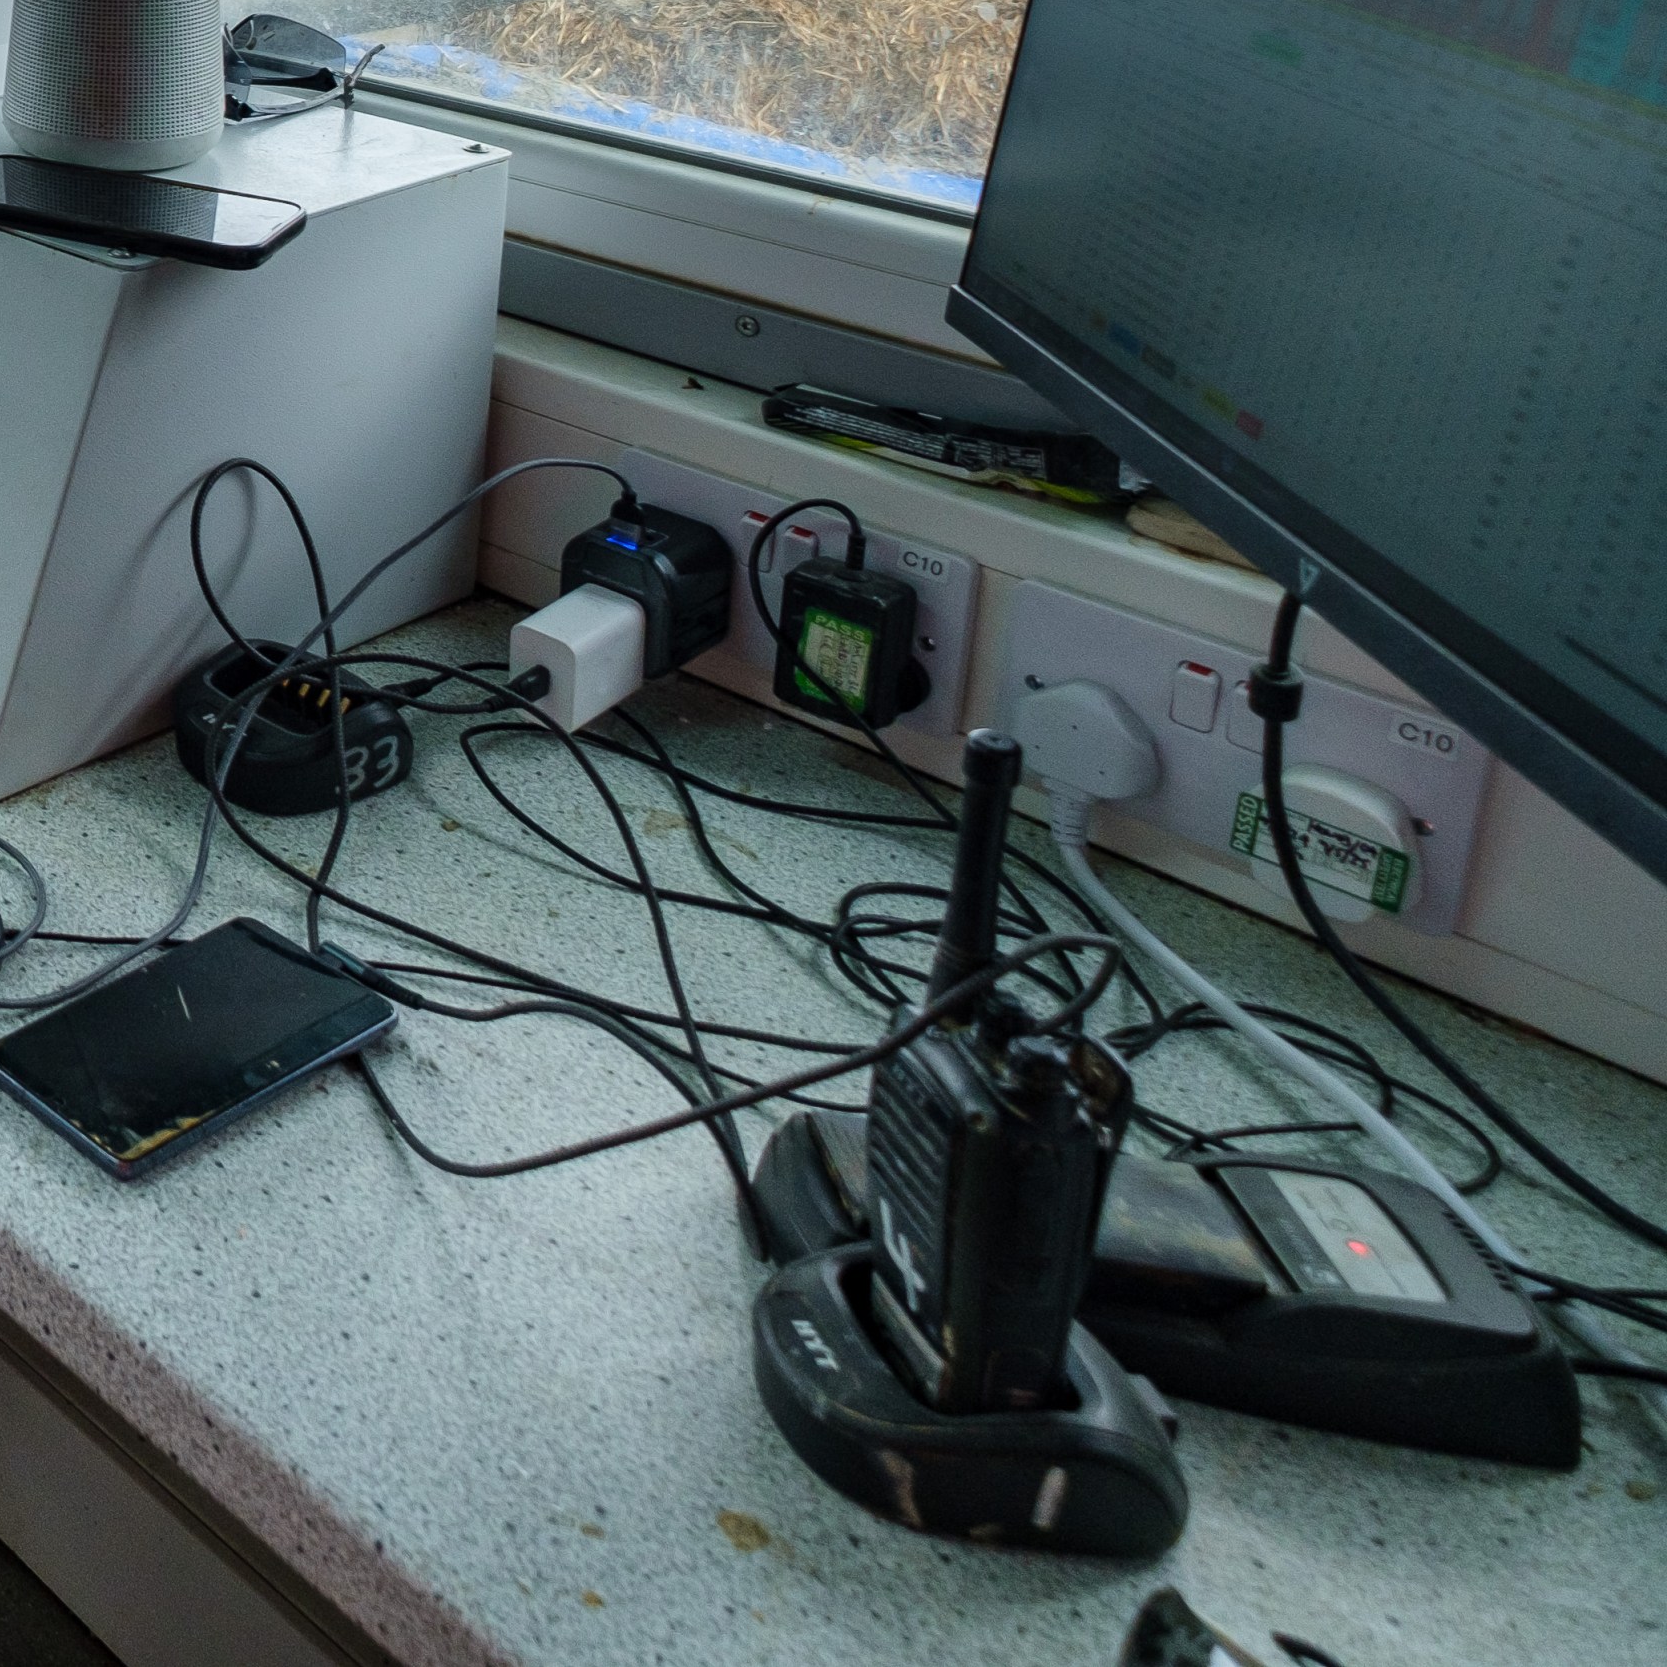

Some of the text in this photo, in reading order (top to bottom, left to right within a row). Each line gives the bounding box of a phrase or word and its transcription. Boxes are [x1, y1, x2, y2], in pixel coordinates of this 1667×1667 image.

[903, 551, 944, 577] C10
[815, 614, 867, 640] PASS
[202, 713, 248, 737] HY
[1398, 722, 1455, 754] C10
[1233, 797, 1260, 851] PASSED
